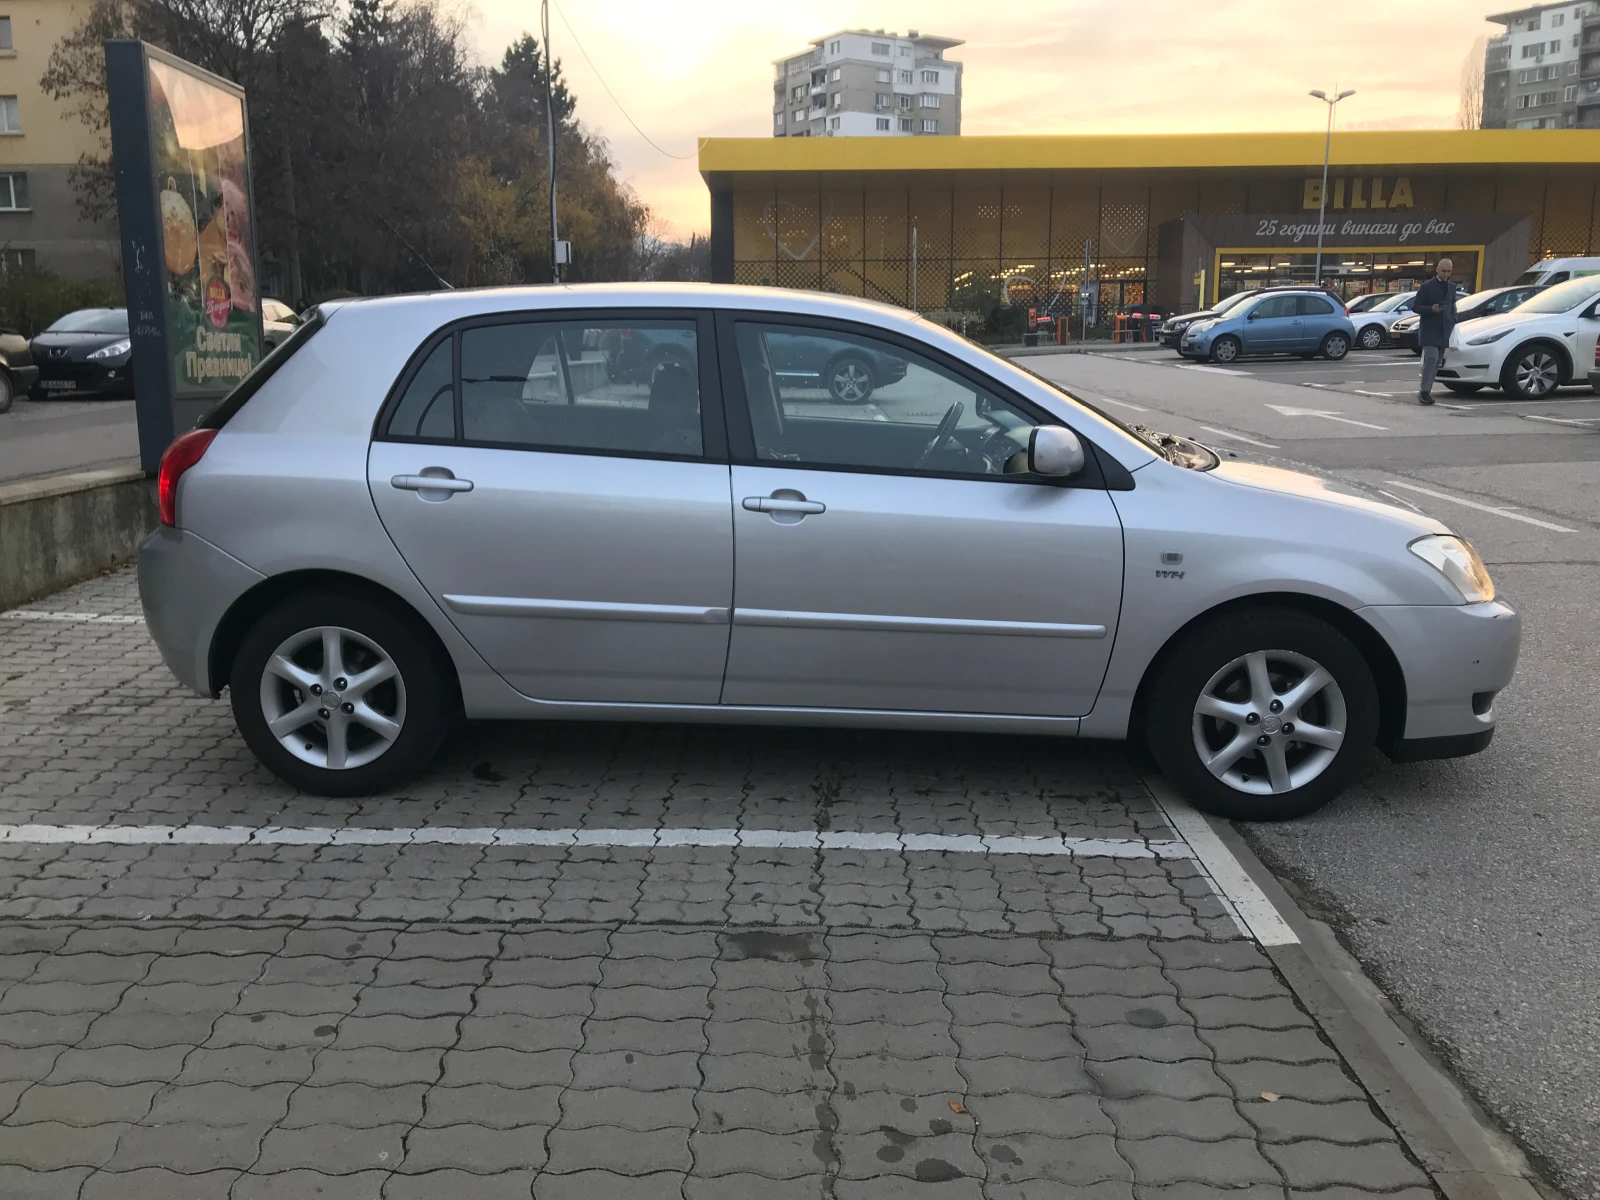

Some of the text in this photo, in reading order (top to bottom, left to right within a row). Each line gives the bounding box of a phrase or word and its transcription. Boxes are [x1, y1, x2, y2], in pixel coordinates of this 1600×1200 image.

[1303, 177, 1414, 209] BILLA
[1255, 218, 1455, 242] 25 години винаги до вас
[196, 325, 242, 352] Светли
[185, 351, 252, 383] Празници!
